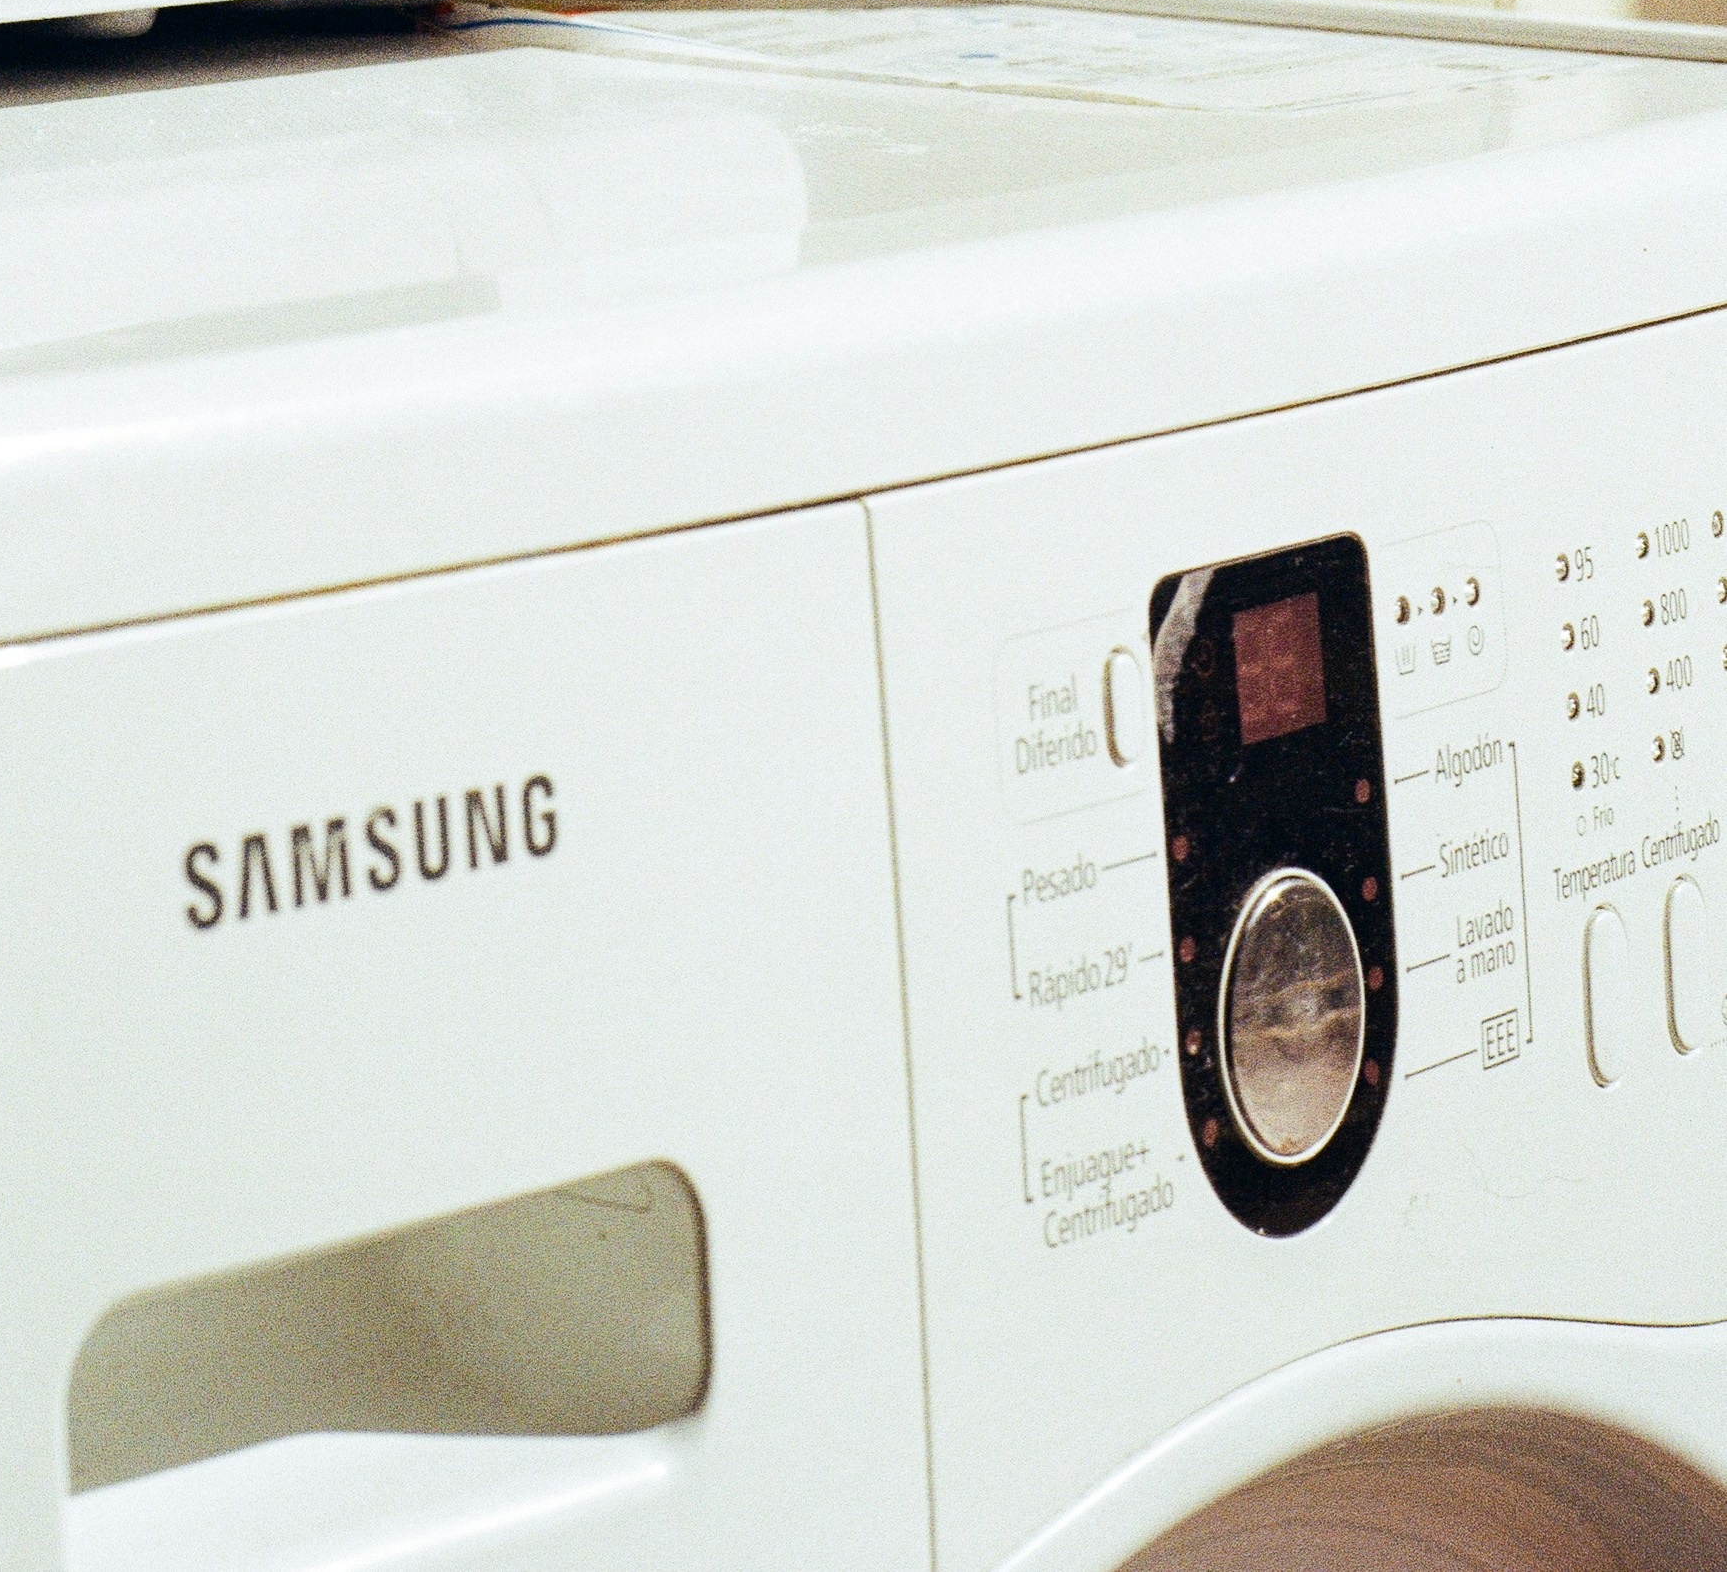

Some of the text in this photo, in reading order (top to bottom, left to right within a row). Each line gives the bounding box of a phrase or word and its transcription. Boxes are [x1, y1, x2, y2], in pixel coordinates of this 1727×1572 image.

[1655, 518, 1690, 558] 1000
[1574, 546, 1594, 582] 95
[1580, 614, 1600, 650] 60
[1660, 588, 1687, 626] 800
[1029, 673, 1078, 722] Final
[1665, 654, 1692, 691] 400
[1586, 683, 1605, 718] 40
[1015, 721, 1097, 775] Diferido
[1435, 733, 1503, 787] Algodón
[184, 772, 558, 932] SAMSUNG
[1438, 827, 1509, 878] Sintético
[1554, 813, 1720, 902] Temperatura Centrifugado
[1022, 852, 1098, 906] Pesado
[1457, 898, 1514, 949] Lavado
[1028, 953, 1101, 1011] Rápido
[1456, 939, 1515, 984] a mano
[1036, 1036, 1160, 1108] Centrifugado
[1044, 1173, 1174, 1250] Centrifugado
